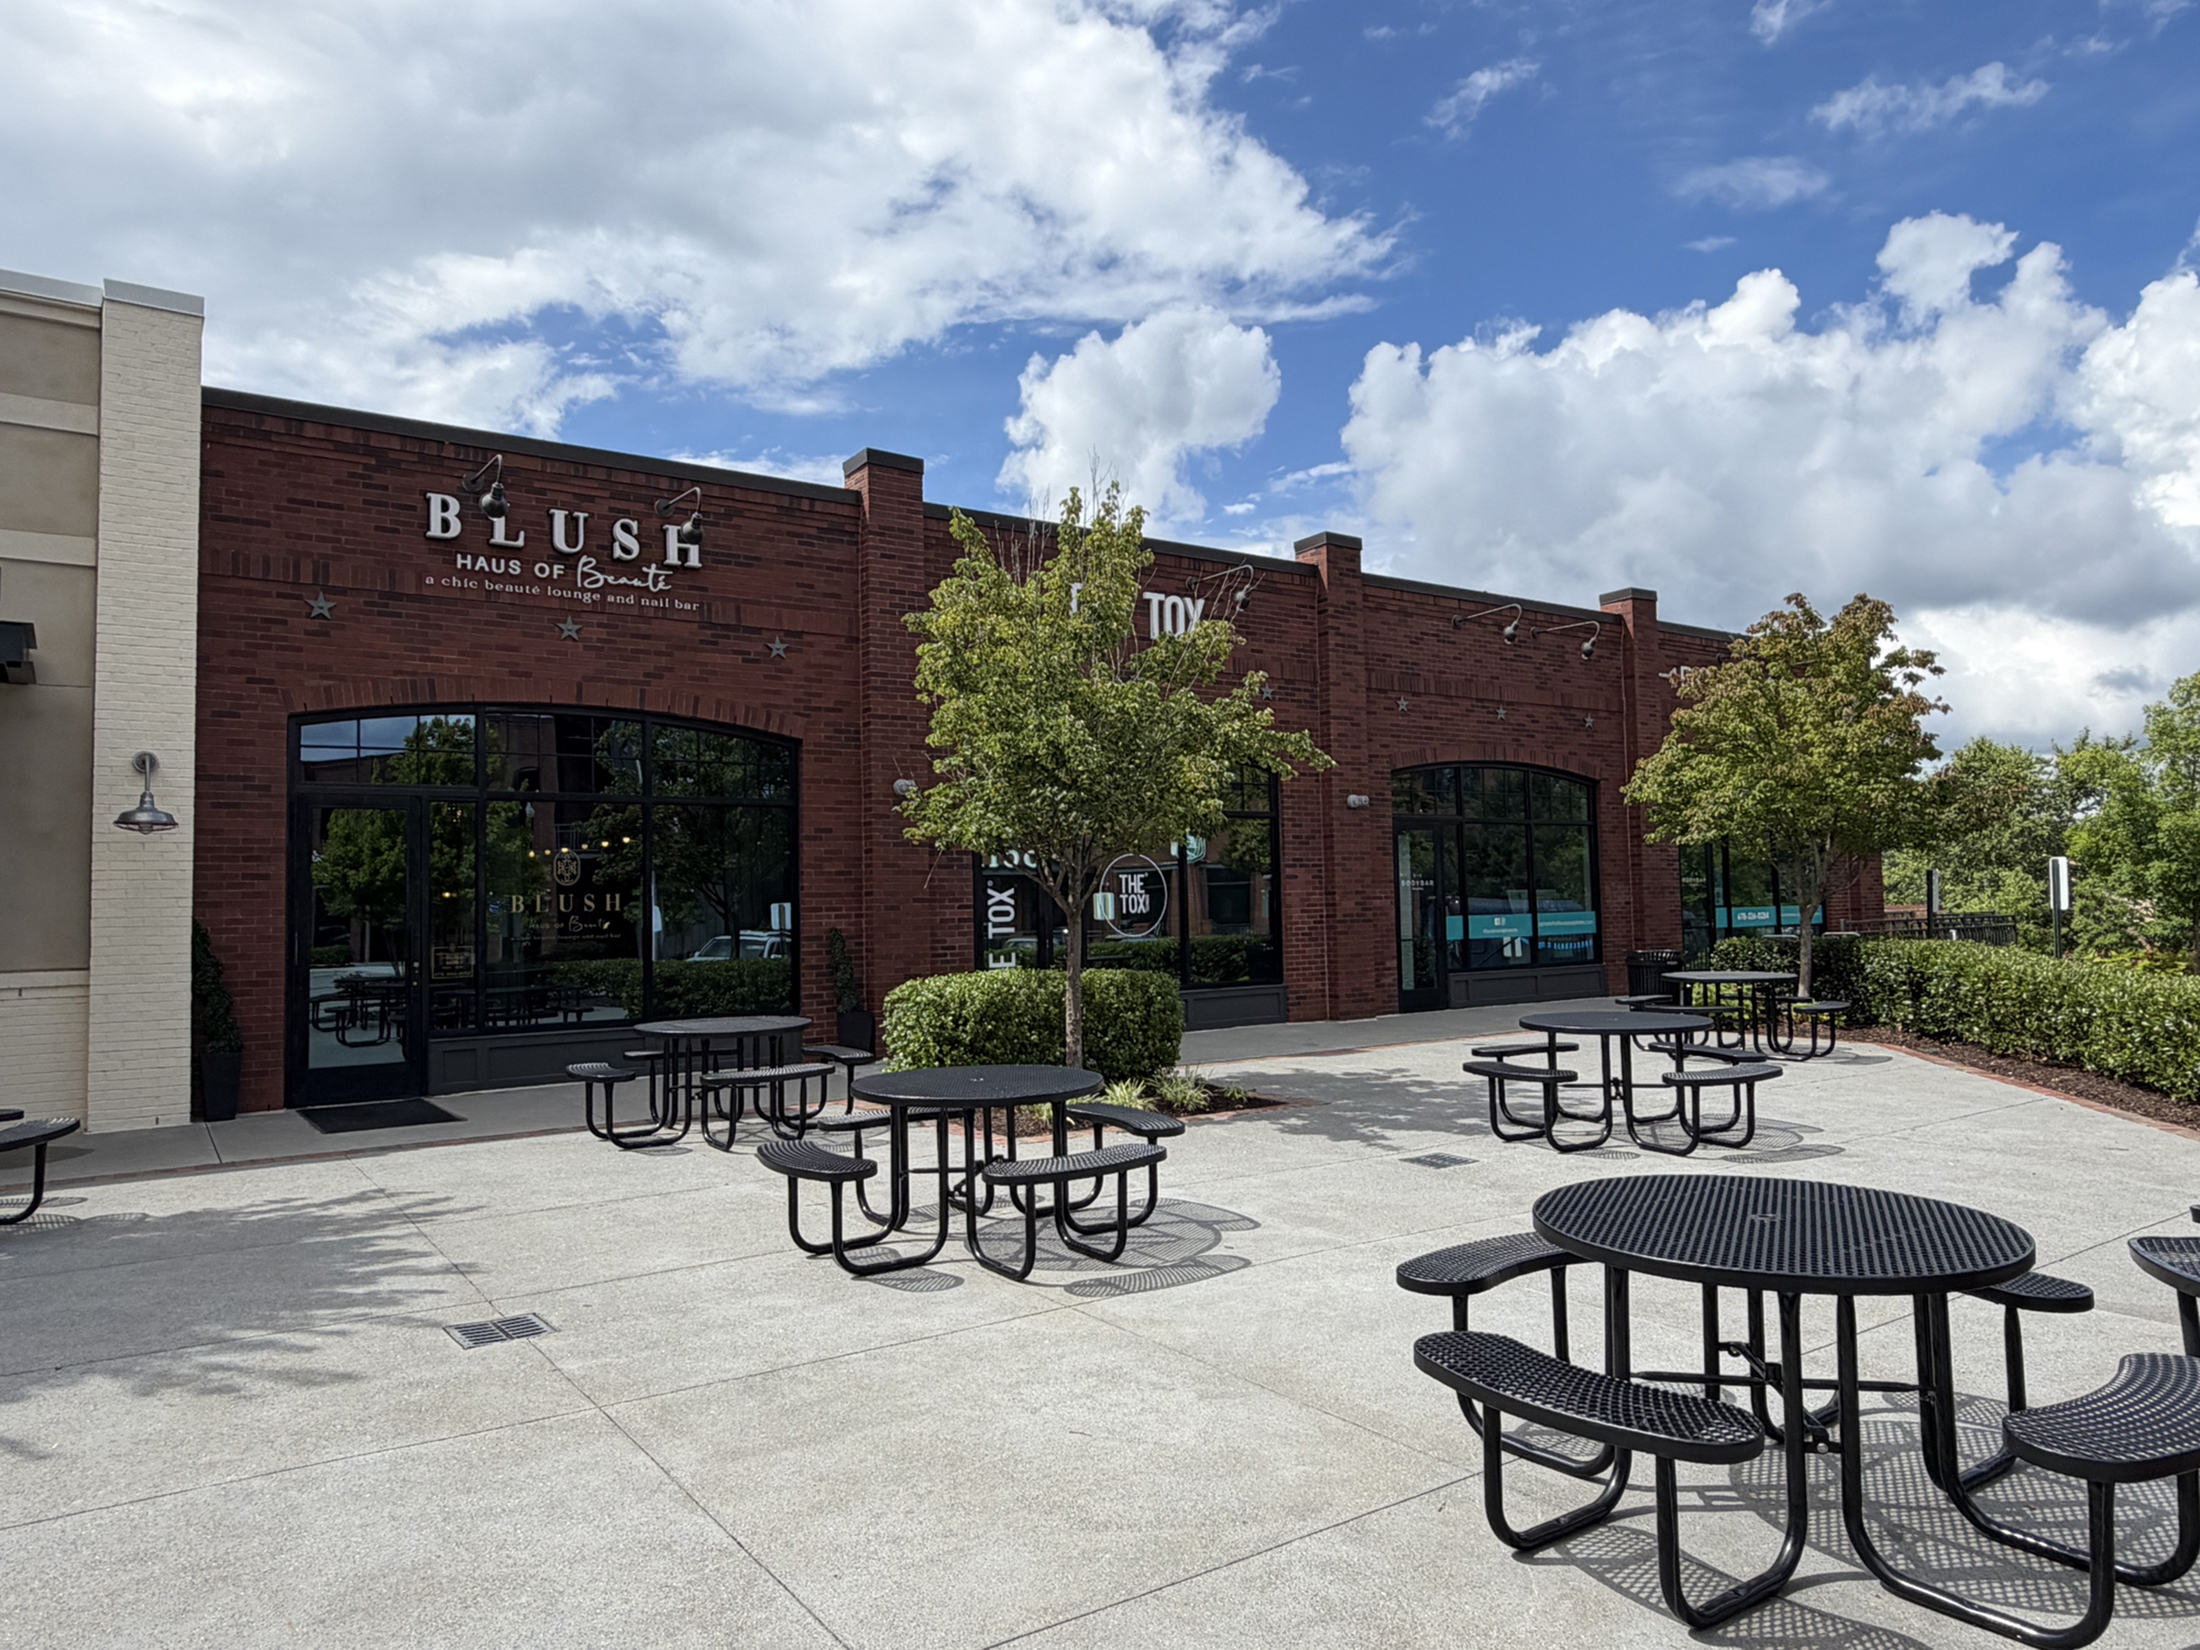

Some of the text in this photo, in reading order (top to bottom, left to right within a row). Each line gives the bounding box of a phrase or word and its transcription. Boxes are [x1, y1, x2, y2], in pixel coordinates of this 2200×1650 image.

[425, 492, 703, 569] BLUSH
[456, 553, 673, 592] HAUS OF Beauté
[425, 576, 700, 611] a chic beauté lounge and nail bar
[1143, 591, 1205, 640] TOX
[1119, 874, 1145, 894] THE
[511, 893, 621, 914] BLUSH
[987, 887, 1016, 940] TOX
[1119, 894, 1147, 914] TOX
[568, 915, 611, 932] Beaut
